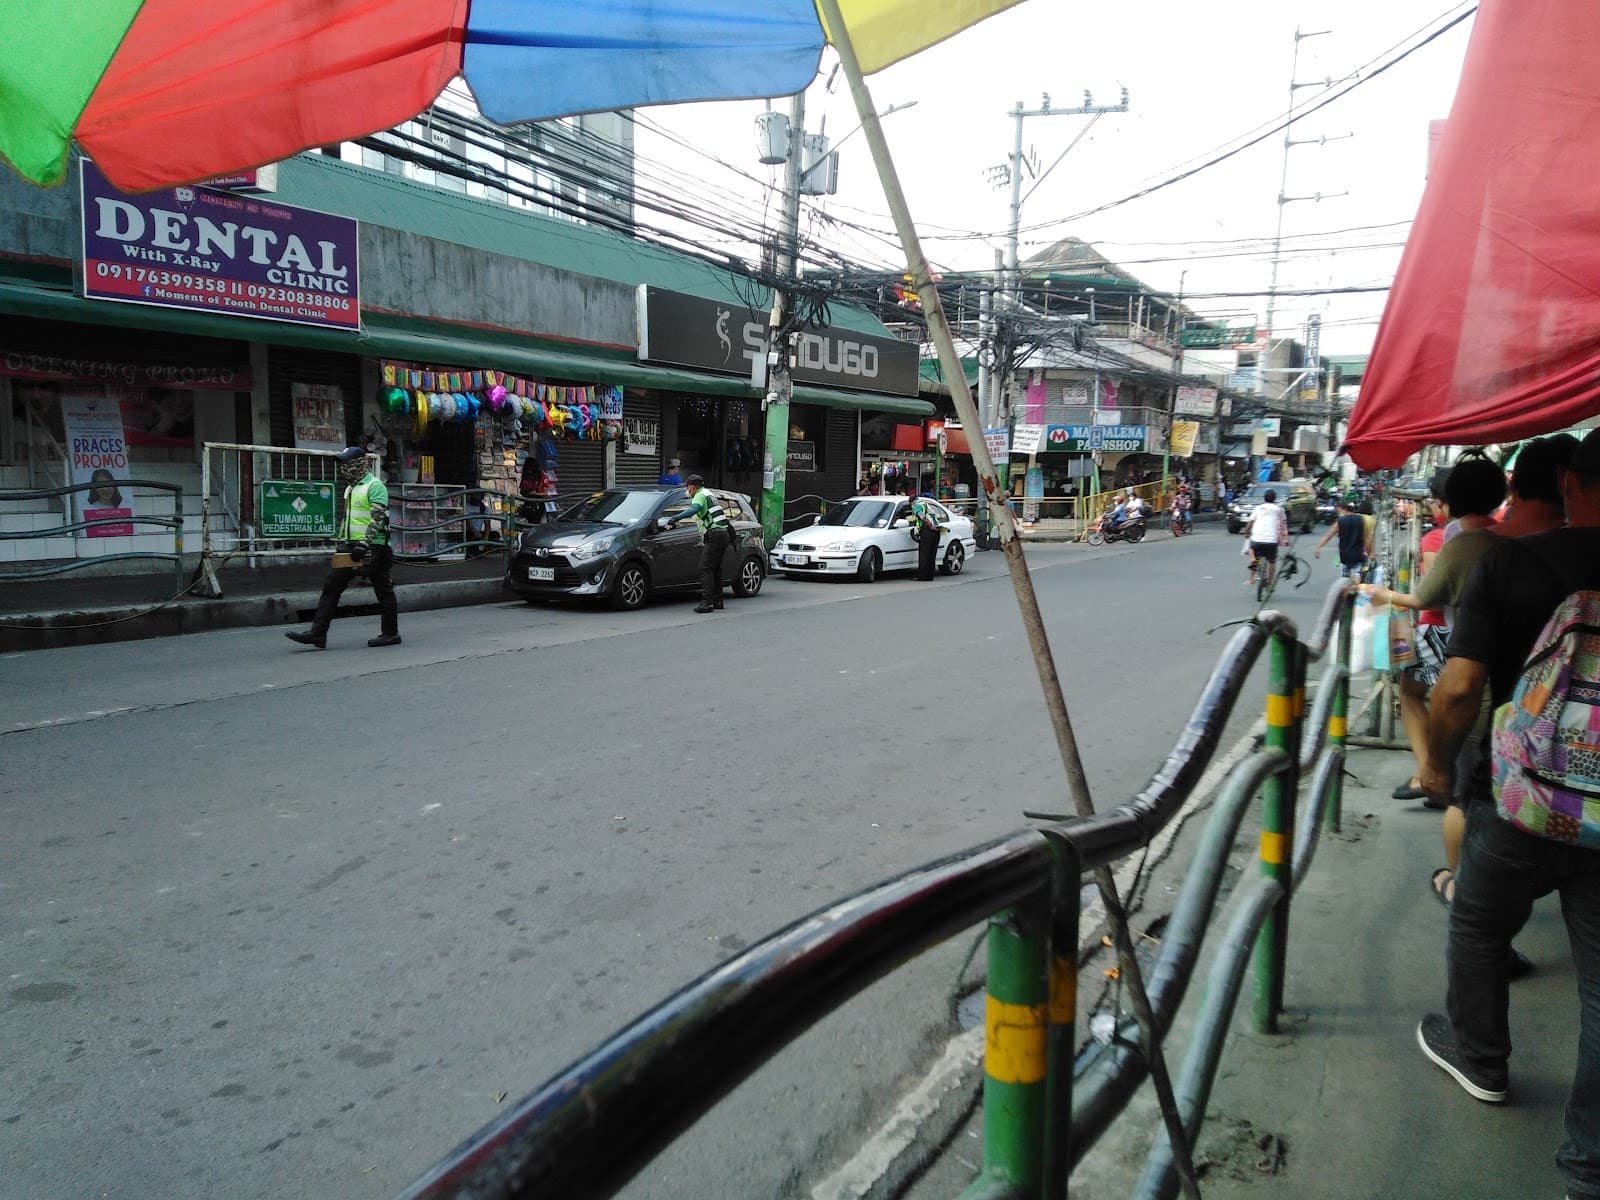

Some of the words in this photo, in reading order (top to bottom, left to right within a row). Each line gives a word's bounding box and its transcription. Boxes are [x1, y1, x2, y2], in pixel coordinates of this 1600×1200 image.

[94, 196, 348, 278] DENTAL
[121, 244, 167, 263] With
[172, 252, 221, 273] X-Ray
[96, 262, 227, 294] 09176399358
[247, 284, 350, 311] 09230838806
[266, 268, 349, 294] CLINIC
[155, 287, 204, 303] Moment
[207, 296, 219, 305] of
[223, 297, 256, 310] Tooth
[260, 301, 294, 315] Dental
[297, 307, 328, 319] Clinic
[742, 321, 879, 379] SDUGO
[1072, 426, 1144, 439] MAALENA
[73, 438, 123, 454] BRACES
[1076, 440, 1140, 451] PANSHOP
[73, 453, 126, 470] PROMO
[263, 523, 313, 534] PEDESTRIAN
[314, 524, 333, 534] LANE
[272, 514, 313, 525] TUMAWID
[313, 514, 325, 525] SA
